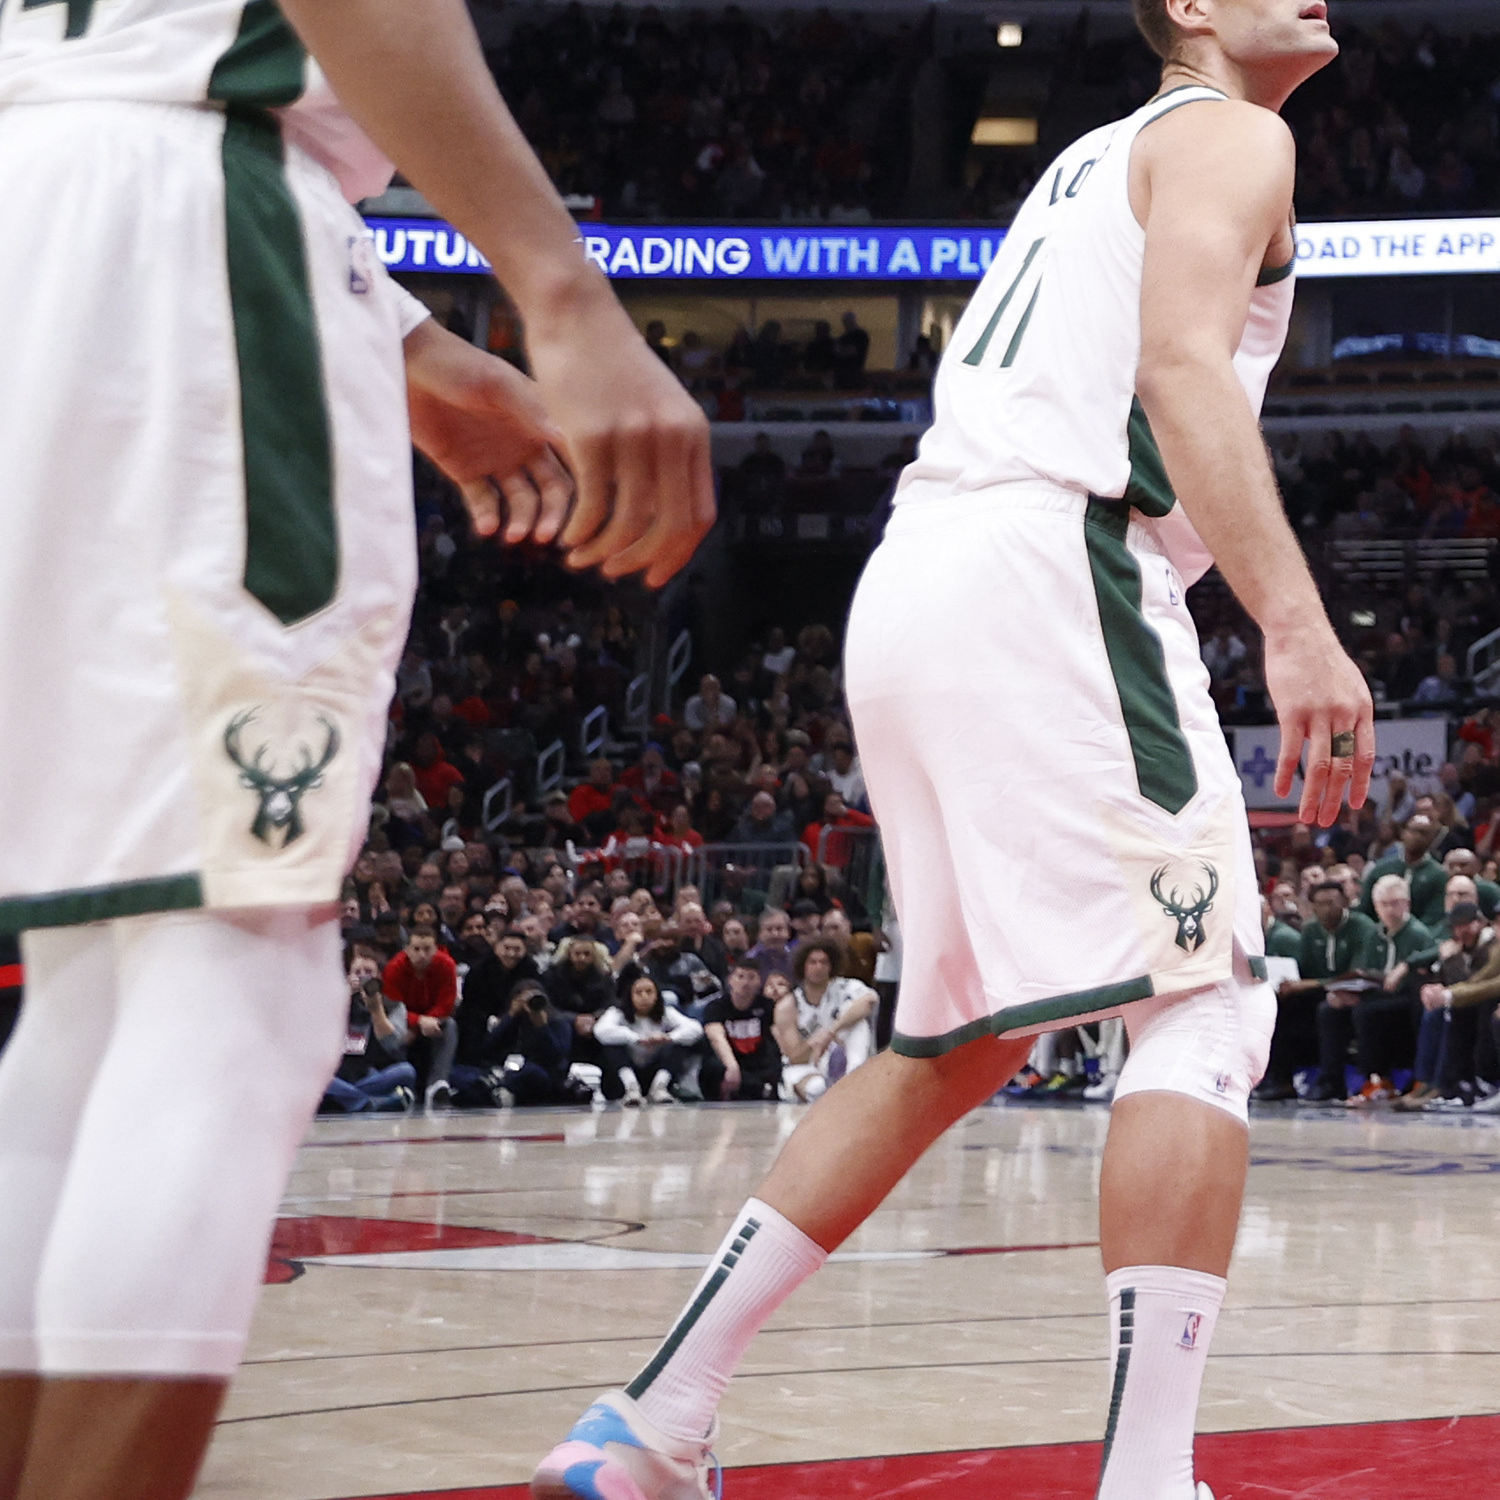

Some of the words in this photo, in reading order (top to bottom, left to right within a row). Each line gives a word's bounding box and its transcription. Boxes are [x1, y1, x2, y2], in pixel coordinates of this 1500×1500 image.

[573, 237, 752, 276] RADING
[761, 237, 880, 275] WITH
[887, 238, 922, 273] A
[1372, 233, 1425, 259] THE
[1435, 231, 1496, 257] APP
